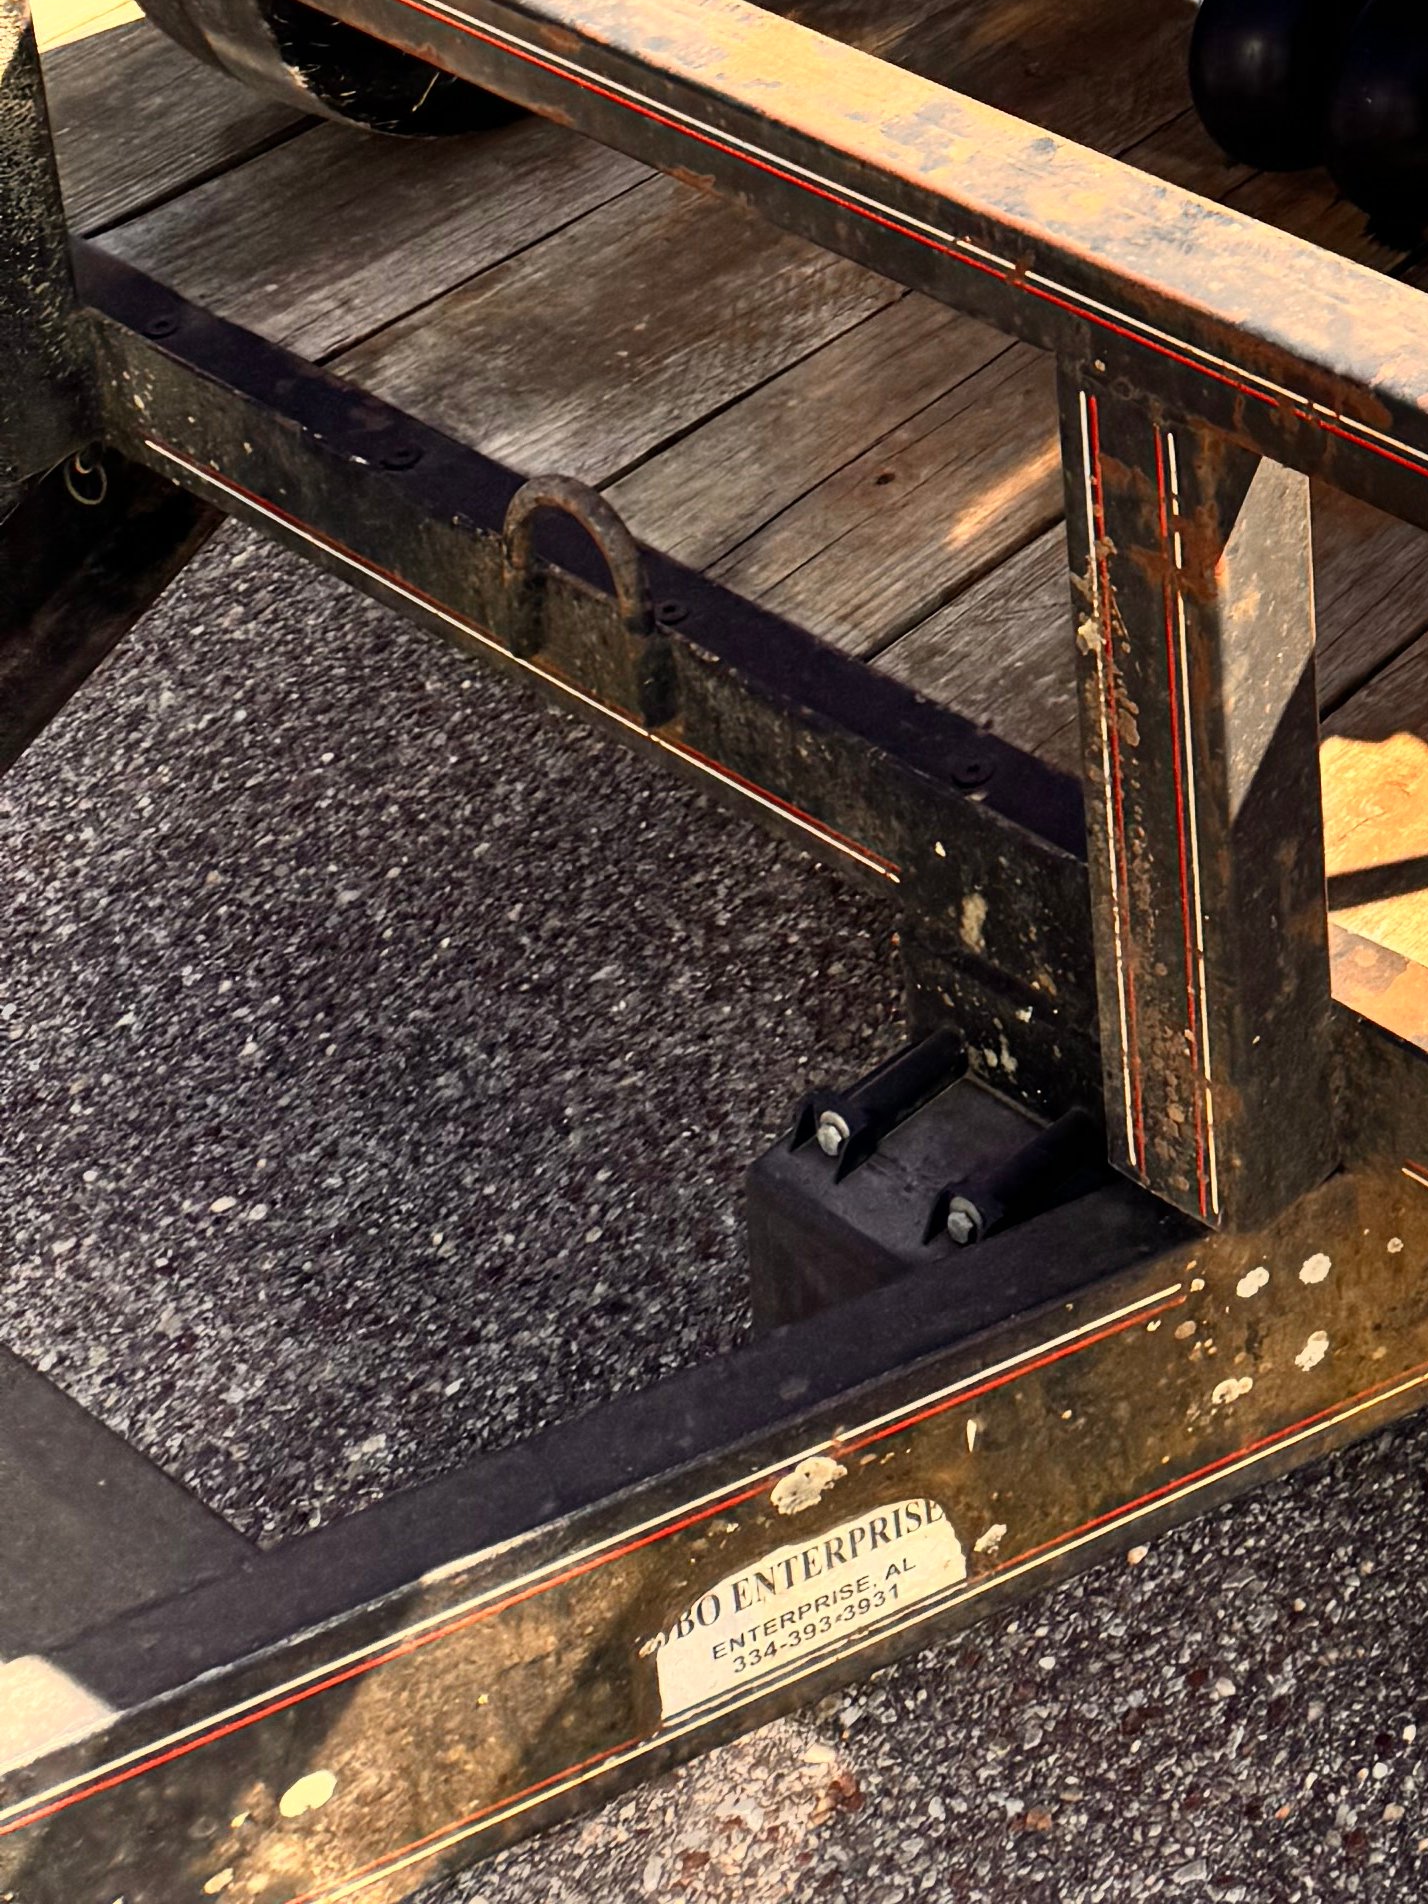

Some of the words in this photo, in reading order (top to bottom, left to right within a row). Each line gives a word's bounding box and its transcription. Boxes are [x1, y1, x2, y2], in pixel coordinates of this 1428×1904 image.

[885, 1558, 917, 1580] AL
[660, 1595, 721, 1648] BO
[732, 1583, 900, 1675] 334-393-3931
